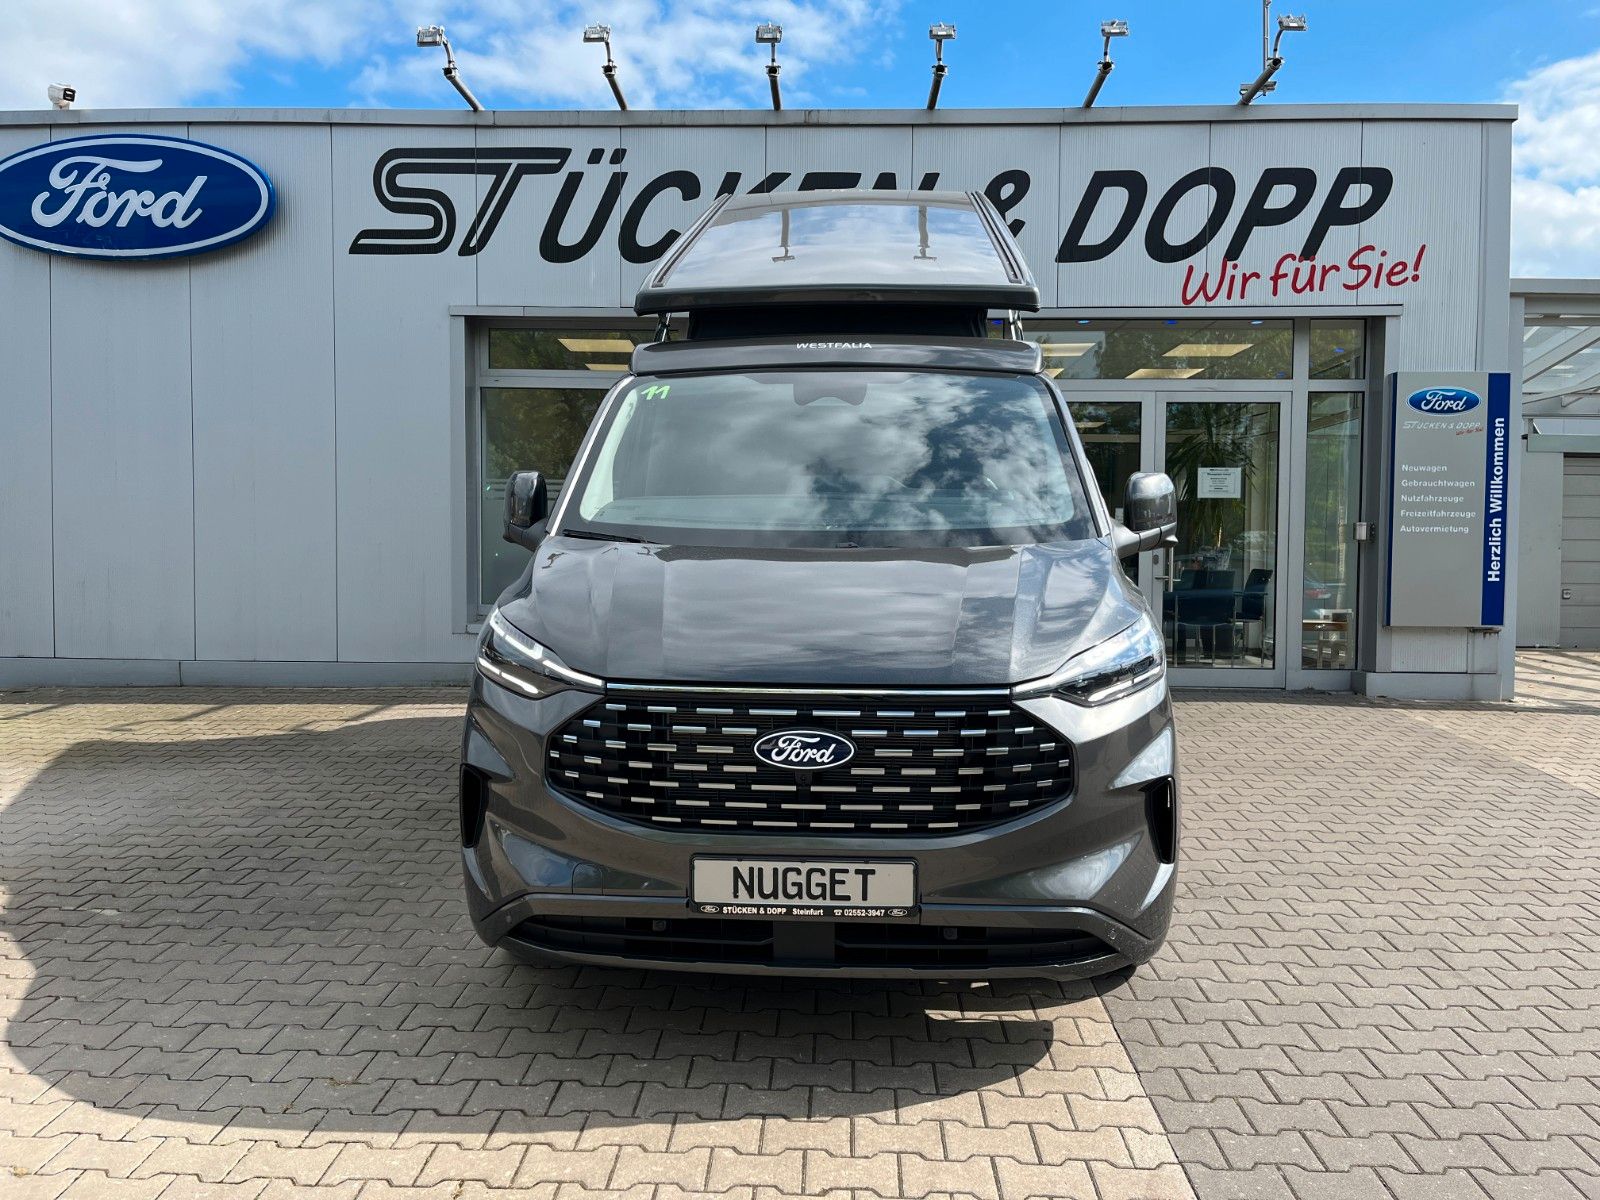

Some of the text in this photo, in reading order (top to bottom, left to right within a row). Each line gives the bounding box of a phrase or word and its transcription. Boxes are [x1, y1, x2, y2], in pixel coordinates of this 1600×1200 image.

[31, 156, 208, 229] Ford
[349, 147, 940, 264] STÜC
[1055, 166, 1394, 263] DOPP
[1181, 244, 1427, 306] Wir für Sie!
[1420, 390, 1467, 411] Ford
[1456, 422, 1481, 430] DOPP
[1401, 464, 1448, 472] Neuwagen
[1401, 479, 1476, 488] Gebrauchtwagen
[1401, 494, 1465, 503] Nutzfahrzeuge
[1487, 417, 1505, 582] Herzlich Willkommen
[1400, 509, 1477, 518] Freizeitfahrzeuge
[1400, 525, 1469, 533] Autovermietung
[771, 735, 837, 763] Ford
[732, 866, 876, 902] NUGGET
[722, 905, 758, 914] STÜCKEN
[767, 907, 787, 915] DOPP
[792, 908, 824, 916] Steinfurt
[843, 909, 885, 917] 02552-3947
